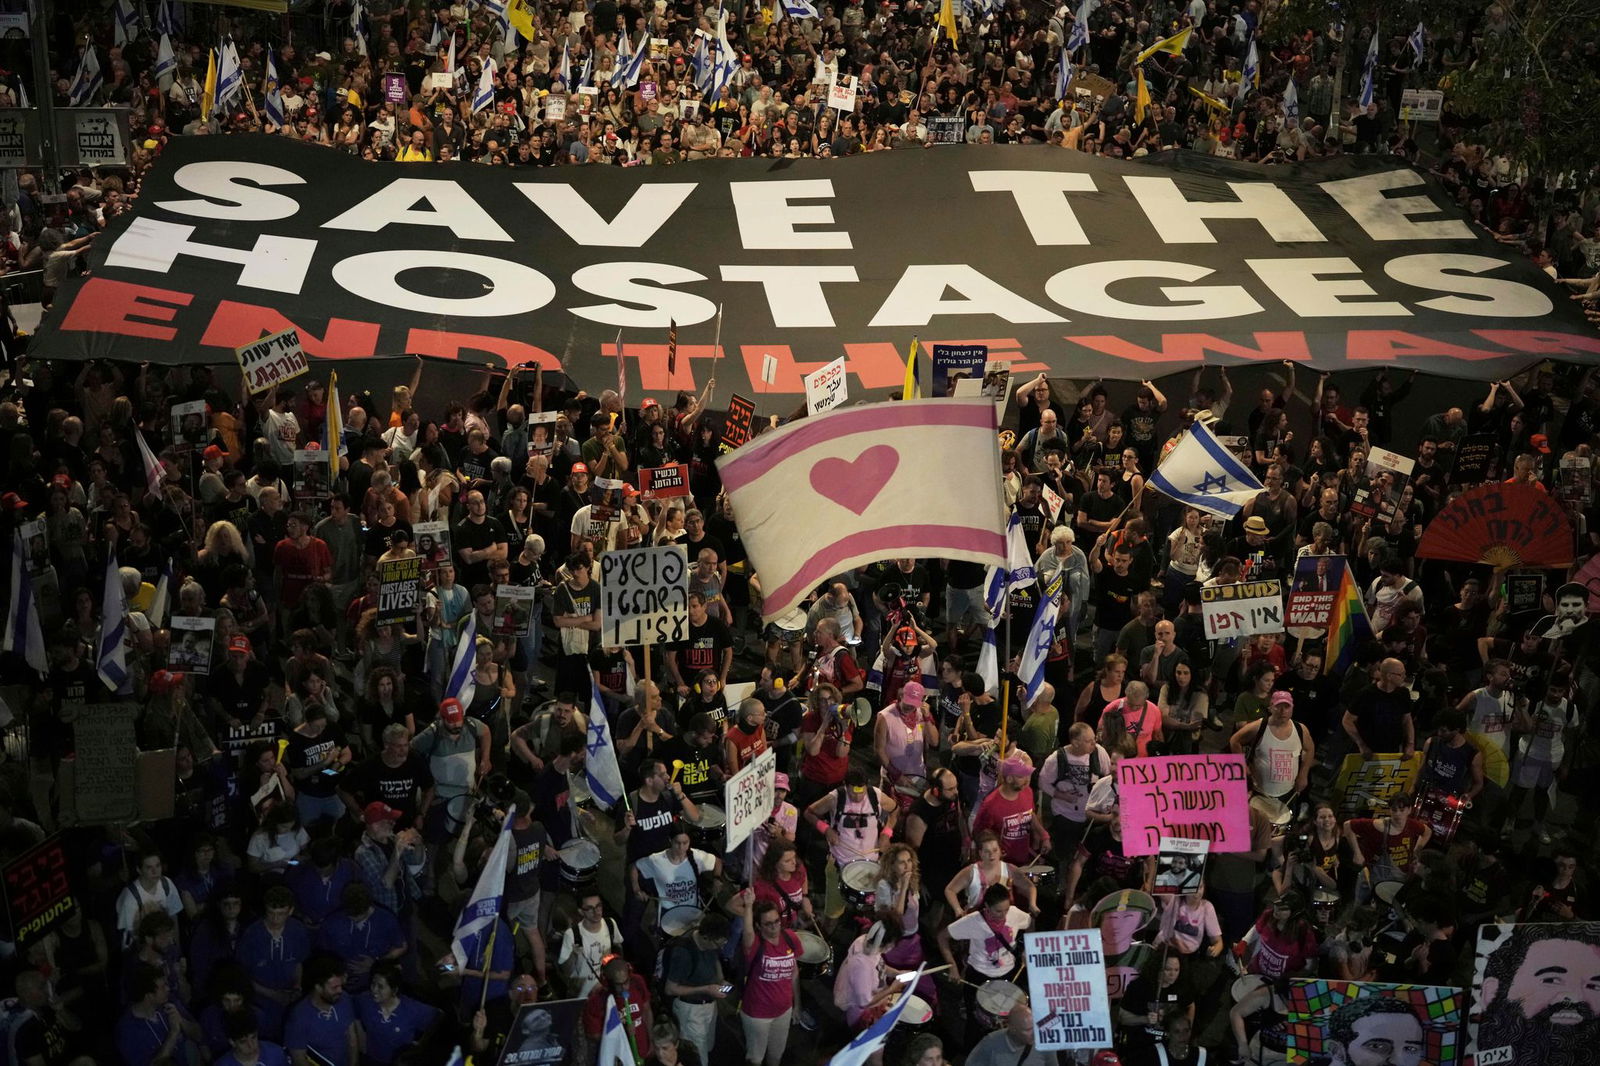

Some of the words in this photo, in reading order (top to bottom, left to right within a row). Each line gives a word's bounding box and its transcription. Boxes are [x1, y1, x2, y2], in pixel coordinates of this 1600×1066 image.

[78, 133, 114, 148] אשם
[81, 148, 115, 158] במחדל
[153, 161, 853, 249] SAVE
[967, 169, 1477, 246] THE
[104, 217, 1553, 328] HOSTAGES
[59, 277, 562, 371] END
[601, 337, 1051, 393] THE
[242, 330, 300, 367] האדישות
[729, 401, 751, 427] ביבי
[726, 420, 746, 445] בוגד
[654, 468, 677, 479] עכשיו
[673, 477, 682, 486] זה
[396, 560, 410, 571] COST
[601, 551, 684, 587] פושעים
[378, 590, 418, 611] LIVES!
[606, 585, 688, 617] השתלטו
[1202, 582, 1279, 602] לחטופים
[1293, 595, 1314, 604] END
[1315, 594, 1334, 602] THIS
[1209, 611, 1245, 634] זמן
[1251, 605, 1281, 629] אין
[1290, 612, 1328, 625] WAR
[614, 614, 688, 645] עלינו
[684, 759, 710, 775] SEAL
[1121, 764, 1157, 785] נצח
[1163, 756, 1246, 784] במלחמת
[683, 770, 709, 785] DEAL
[1145, 786, 1169, 818] לך
[1173, 789, 1225, 811] תעשה
[8, 847, 66, 888] ביבי
[16, 896, 73, 943] בחטופים
[1035, 936, 1061, 953] וזיני
[1064, 935, 1089, 950] ביבי
[1029, 953, 1063, 968] האחורי
[1065, 951, 1100, 965] במושב
[1056, 967, 1075, 981] נגד
[1043, 981, 1091, 998] עסקאות
[1048, 997, 1091, 1013] חטופים
[1058, 1012, 1083, 1028] בעד
[1065, 1025, 1106, 1044] מלחמת
[1477, 1049, 1508, 1066] איתן
